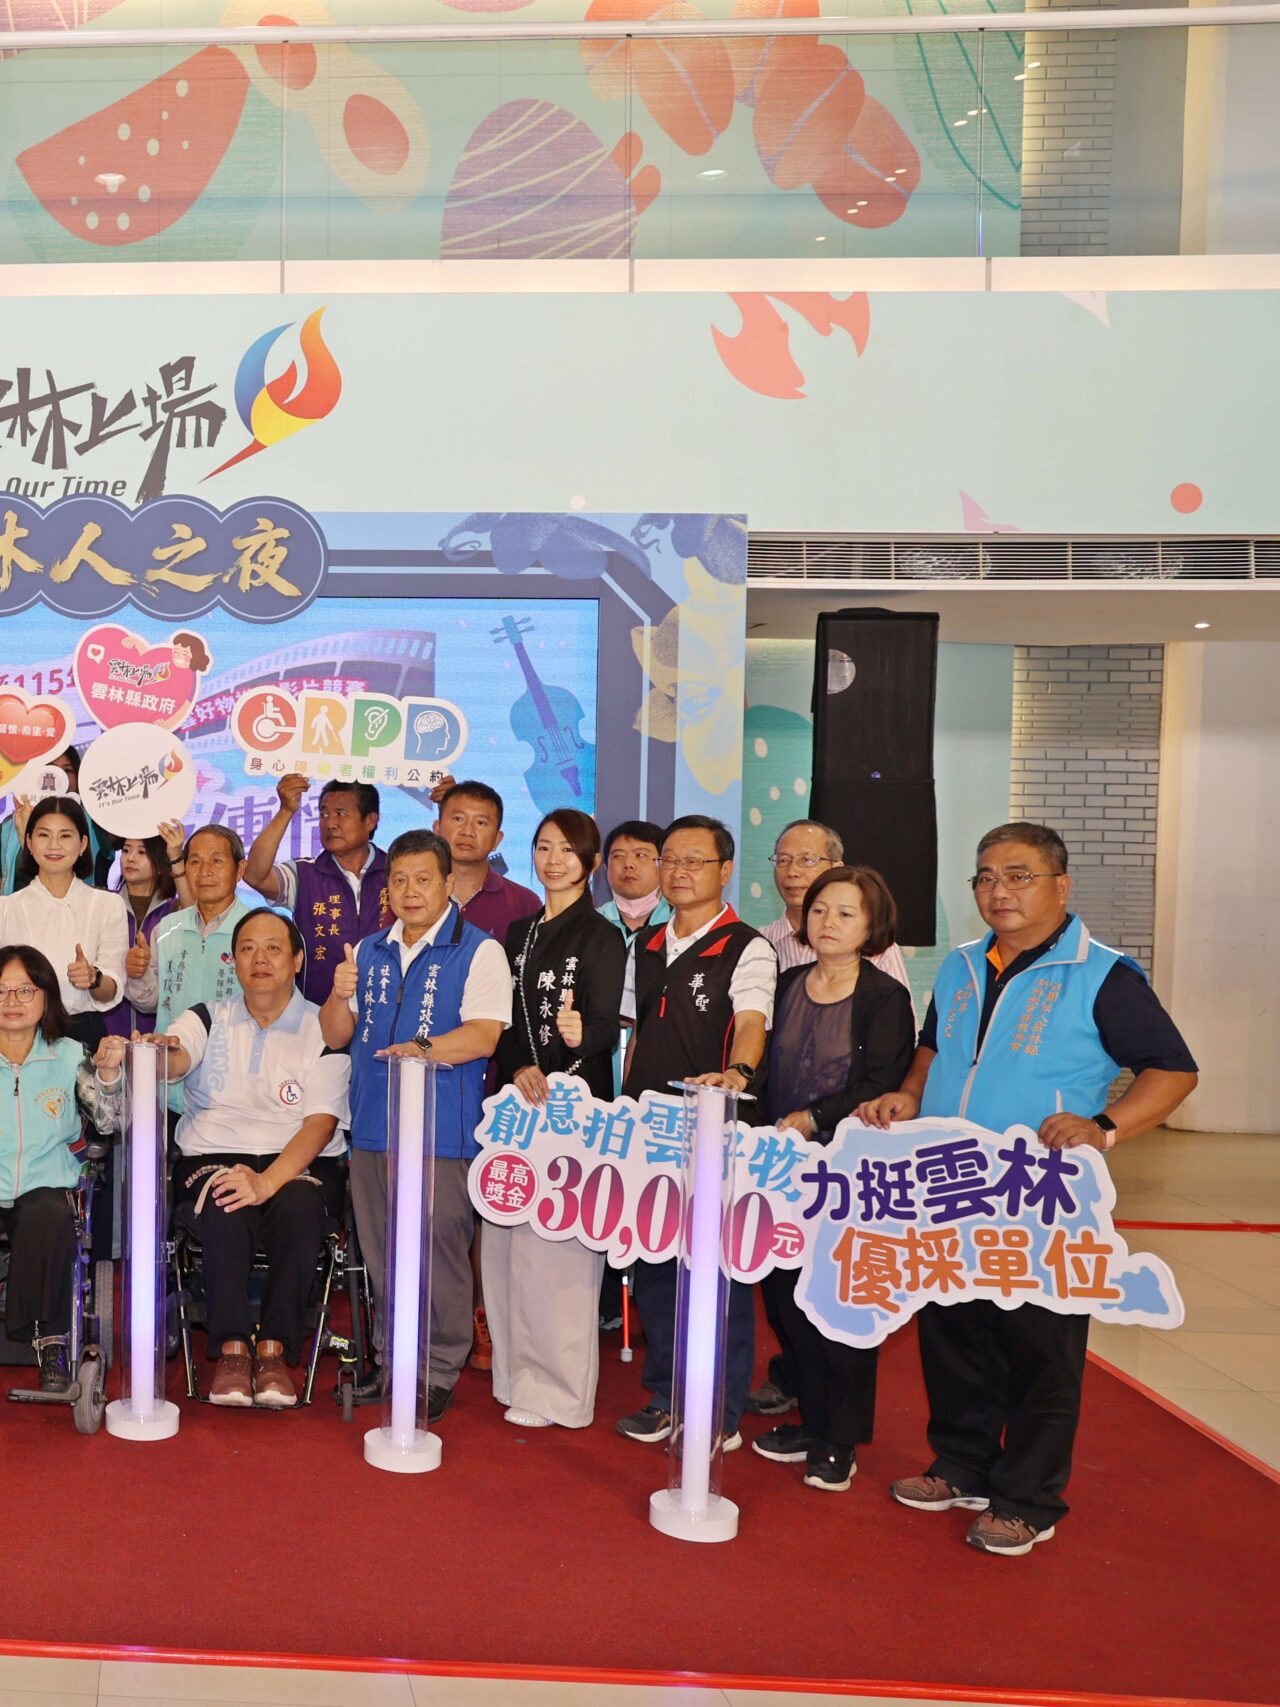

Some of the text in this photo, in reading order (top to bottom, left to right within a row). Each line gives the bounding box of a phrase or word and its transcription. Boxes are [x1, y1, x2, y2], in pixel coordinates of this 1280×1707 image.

[5, 477, 55, 498] Our
[62, 476, 127, 497] Time
[90, 682, 176, 714] 雲林縣政府
[237, 692, 461, 762] CRPD
[312, 902, 327, 961] 張文宏
[328, 894, 342, 936] 理事長
[378, 964, 391, 1004] 社會處
[415, 963, 441, 1039] 雲林縣政府
[537, 969, 557, 1046] 陳永修
[558, 956, 579, 1010] 雲林
[688, 973, 711, 1012] 華聖
[484, 1081, 811, 1203] 創意拍雲物
[485, 1182, 528, 1210] 獎金
[489, 1160, 528, 1187] 最高
[801, 1137, 1079, 1226] 力挺雲林
[537, 1155, 800, 1273] 30,00 元
[832, 1226, 1121, 1314] 優採單位
